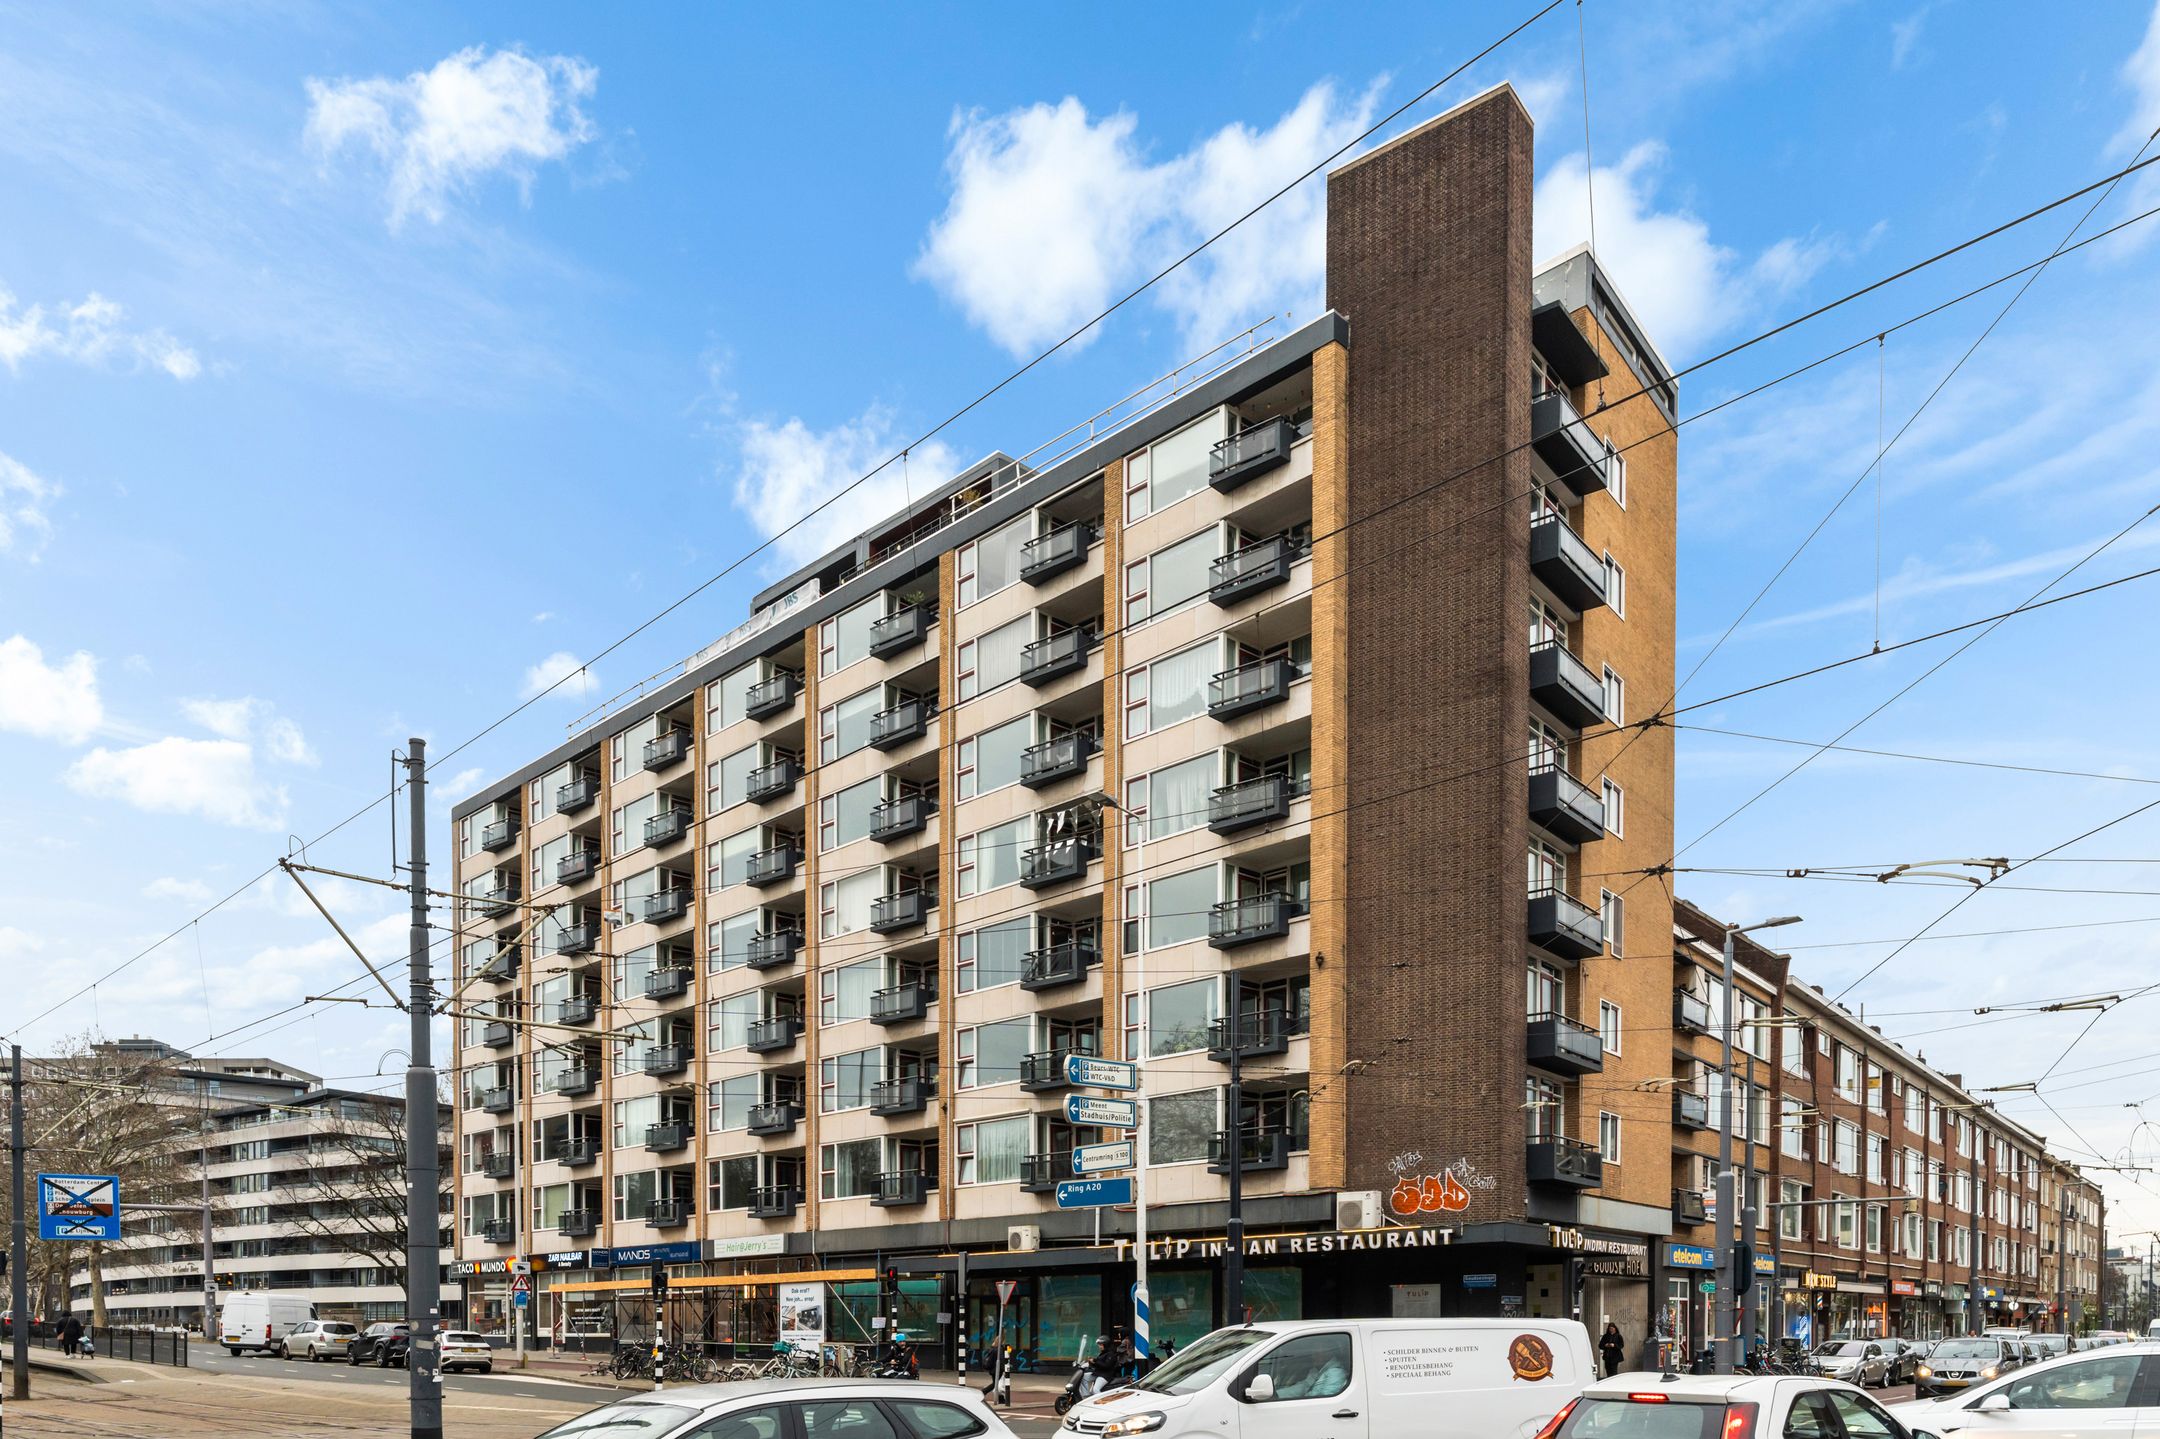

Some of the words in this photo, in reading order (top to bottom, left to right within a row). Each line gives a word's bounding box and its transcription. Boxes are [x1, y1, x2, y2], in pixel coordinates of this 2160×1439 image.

[1080, 1110, 1132, 1122] Stadhuis/Politie
[1082, 1154, 1114, 1163] Centrumring
[1067, 1184, 1084, 1194] Ring
[1086, 1182, 1102, 1191] A20
[1290, 1228, 1453, 1253] RESTAURANT
[1583, 1239, 1608, 1253] INDIAN
[1608, 1241, 1648, 1256] RESTAURANT
[1673, 1248, 1702, 1265] etelcom
[457, 1263, 474, 1274] TACO
[480, 1261, 506, 1273] MUNDO
[1389, 1362, 1454, 1371] RENOVLIESBEHANG
